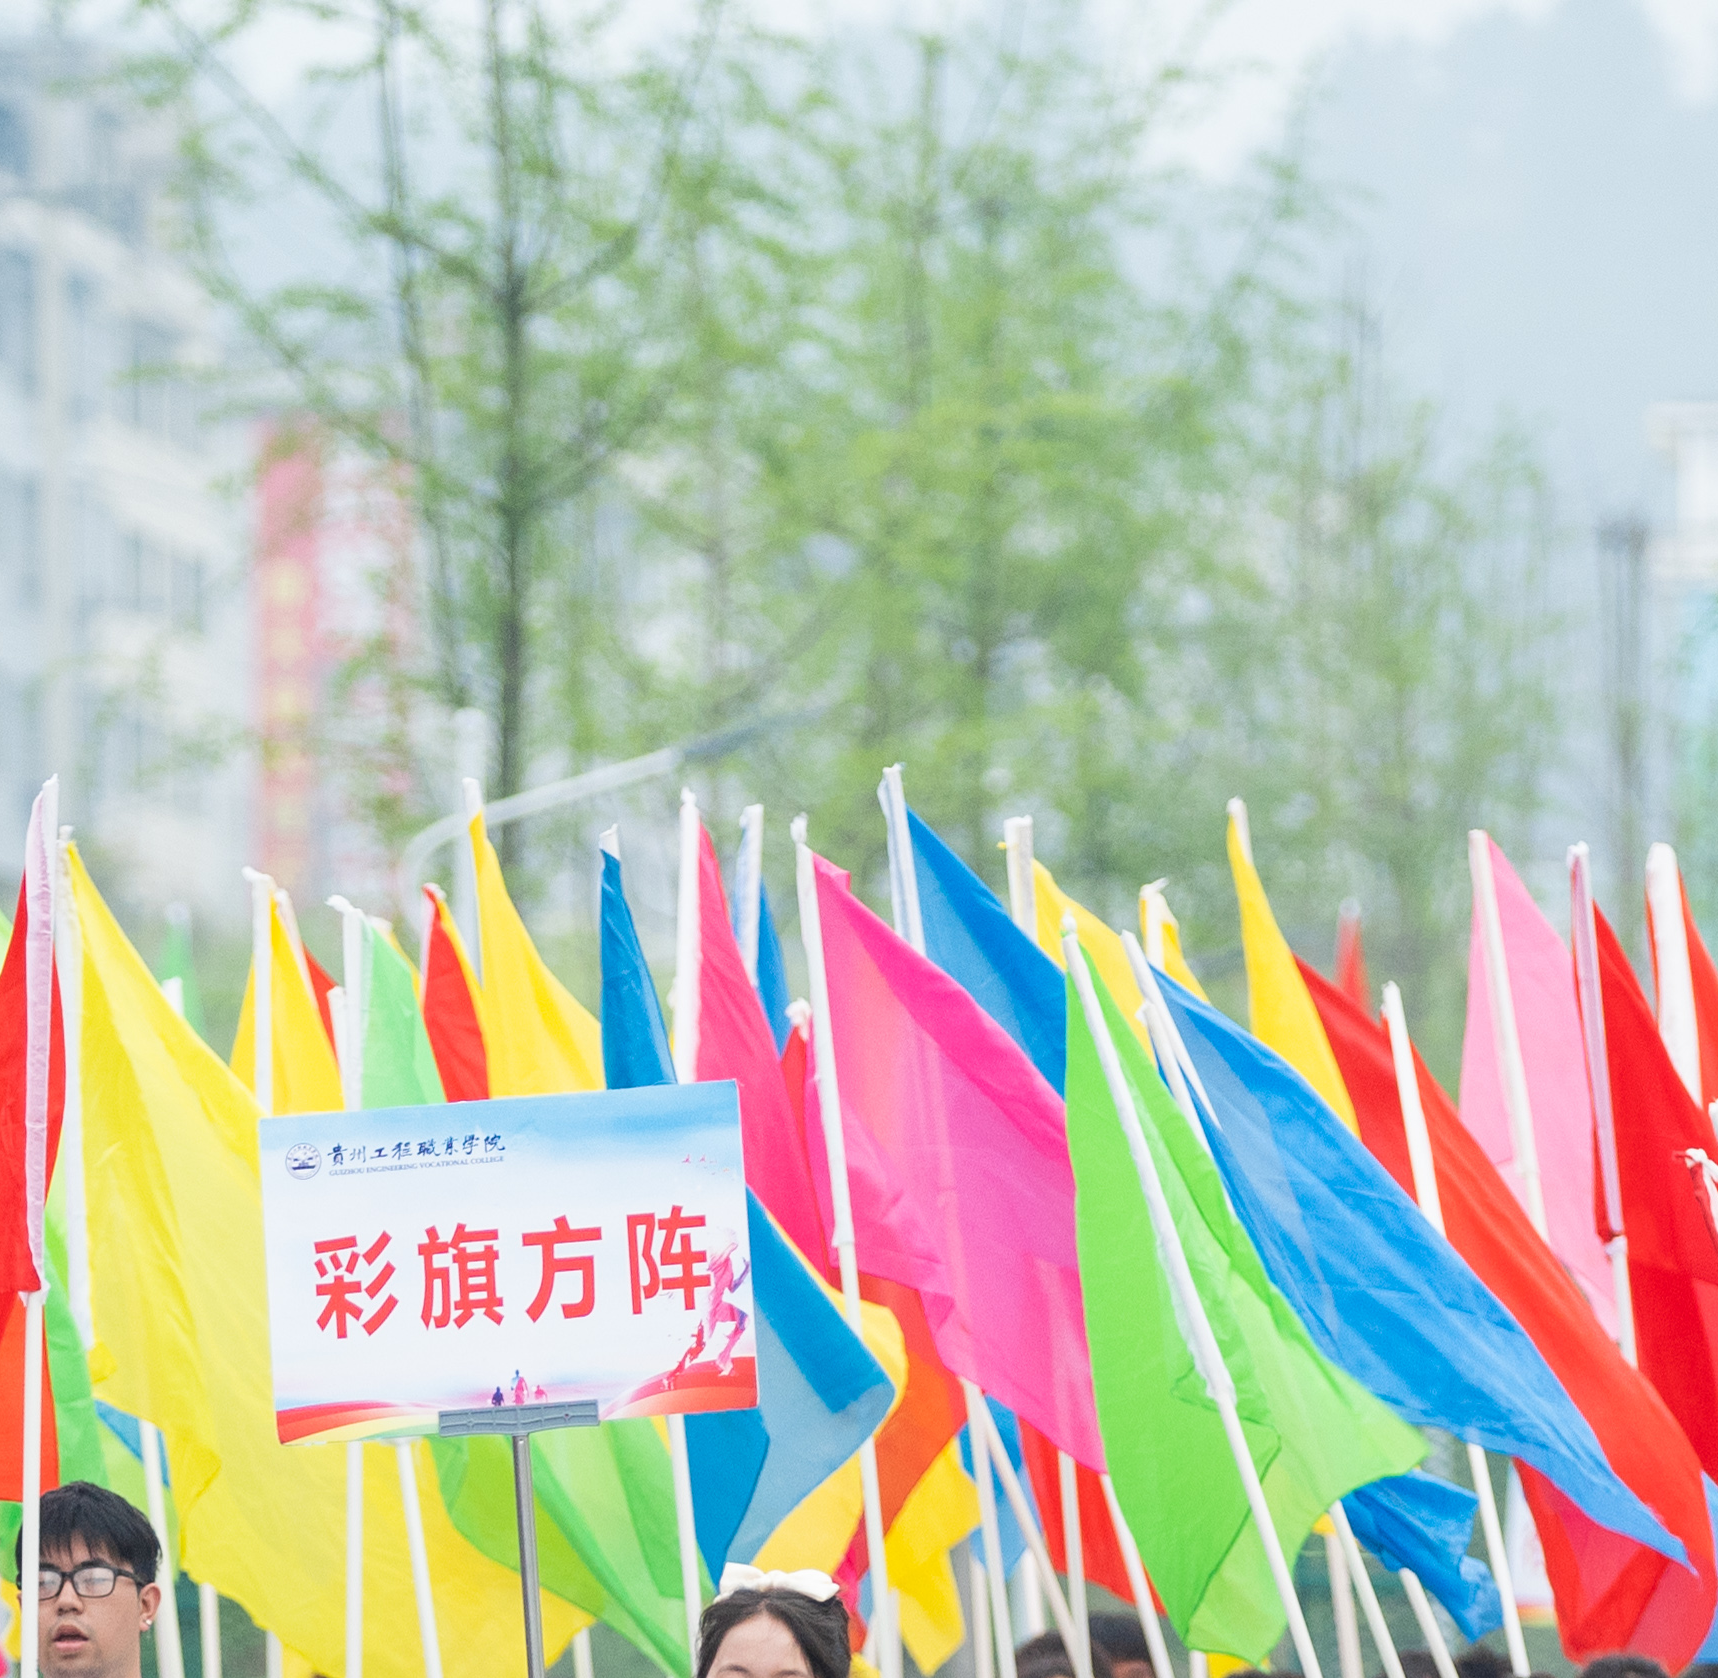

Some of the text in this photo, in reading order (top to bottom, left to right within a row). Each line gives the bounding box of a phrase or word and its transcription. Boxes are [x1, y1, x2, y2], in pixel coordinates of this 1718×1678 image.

[329, 1156, 504, 1176] GUIZHOU ENGINEERING VOCATIONAL COLLEGE
[313, 1205, 713, 1340] 彩旗方阵
